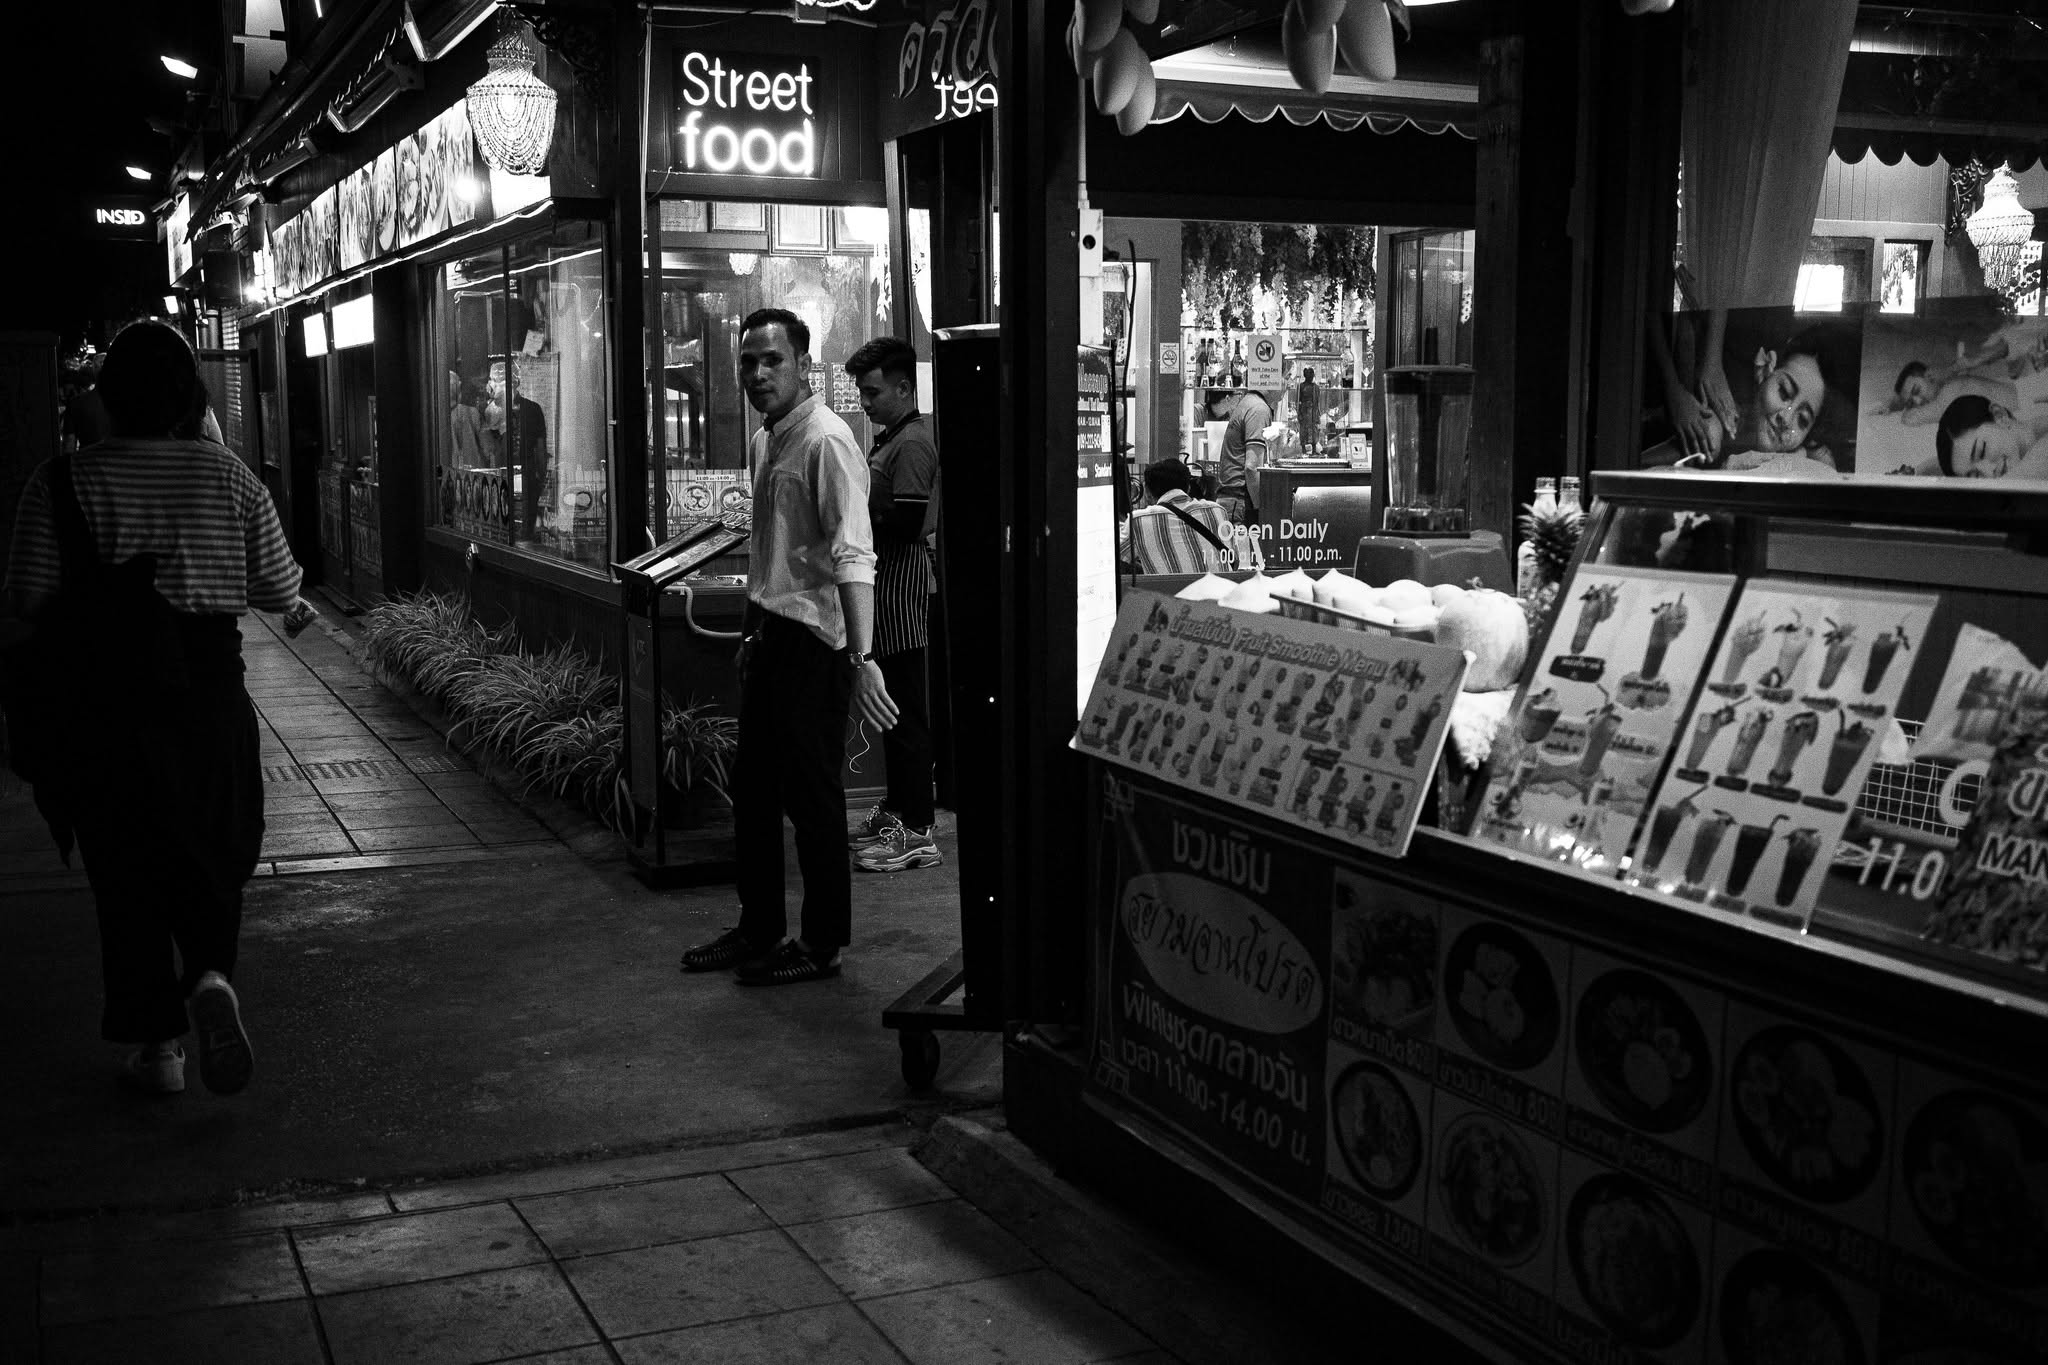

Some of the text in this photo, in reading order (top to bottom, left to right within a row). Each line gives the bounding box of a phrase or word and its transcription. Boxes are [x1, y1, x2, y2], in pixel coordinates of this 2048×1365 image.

[681, 51, 813, 115] Street
[680, 111, 816, 177] food
[1202, 548, 1235, 564] 11.00
[1280, 546, 1311, 562] 11.00
[1315, 548, 1342, 564] p.m.
[1217, 518, 1329, 543] Open Daily
[1267, 634, 1341, 674] Smoothie
[1857, 836, 1948, 900] 11.0
